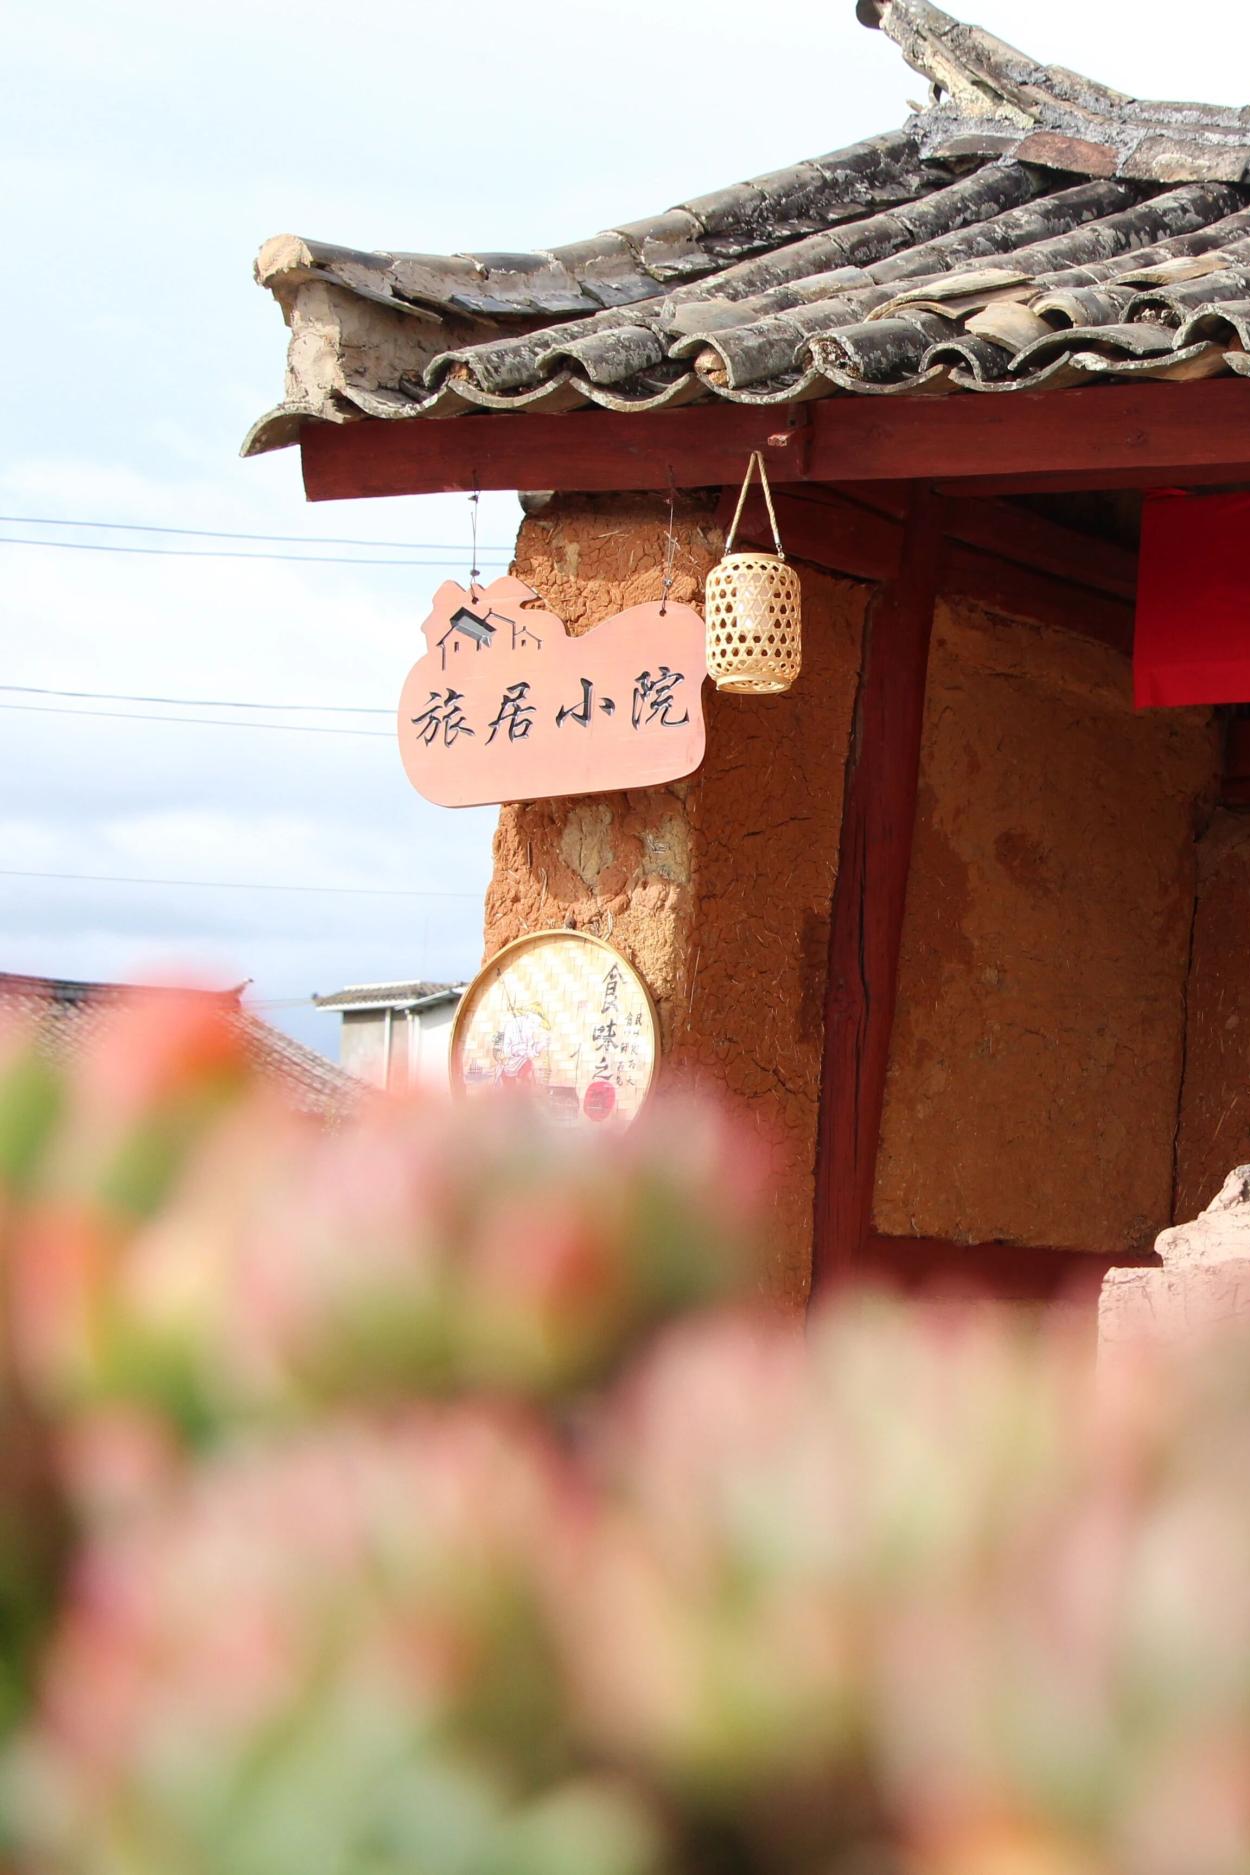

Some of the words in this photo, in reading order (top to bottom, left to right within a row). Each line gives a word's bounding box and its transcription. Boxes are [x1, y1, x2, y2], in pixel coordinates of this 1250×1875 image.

[411, 666, 690, 748] 旅居小院
[586, 963, 627, 1117] 食味之
